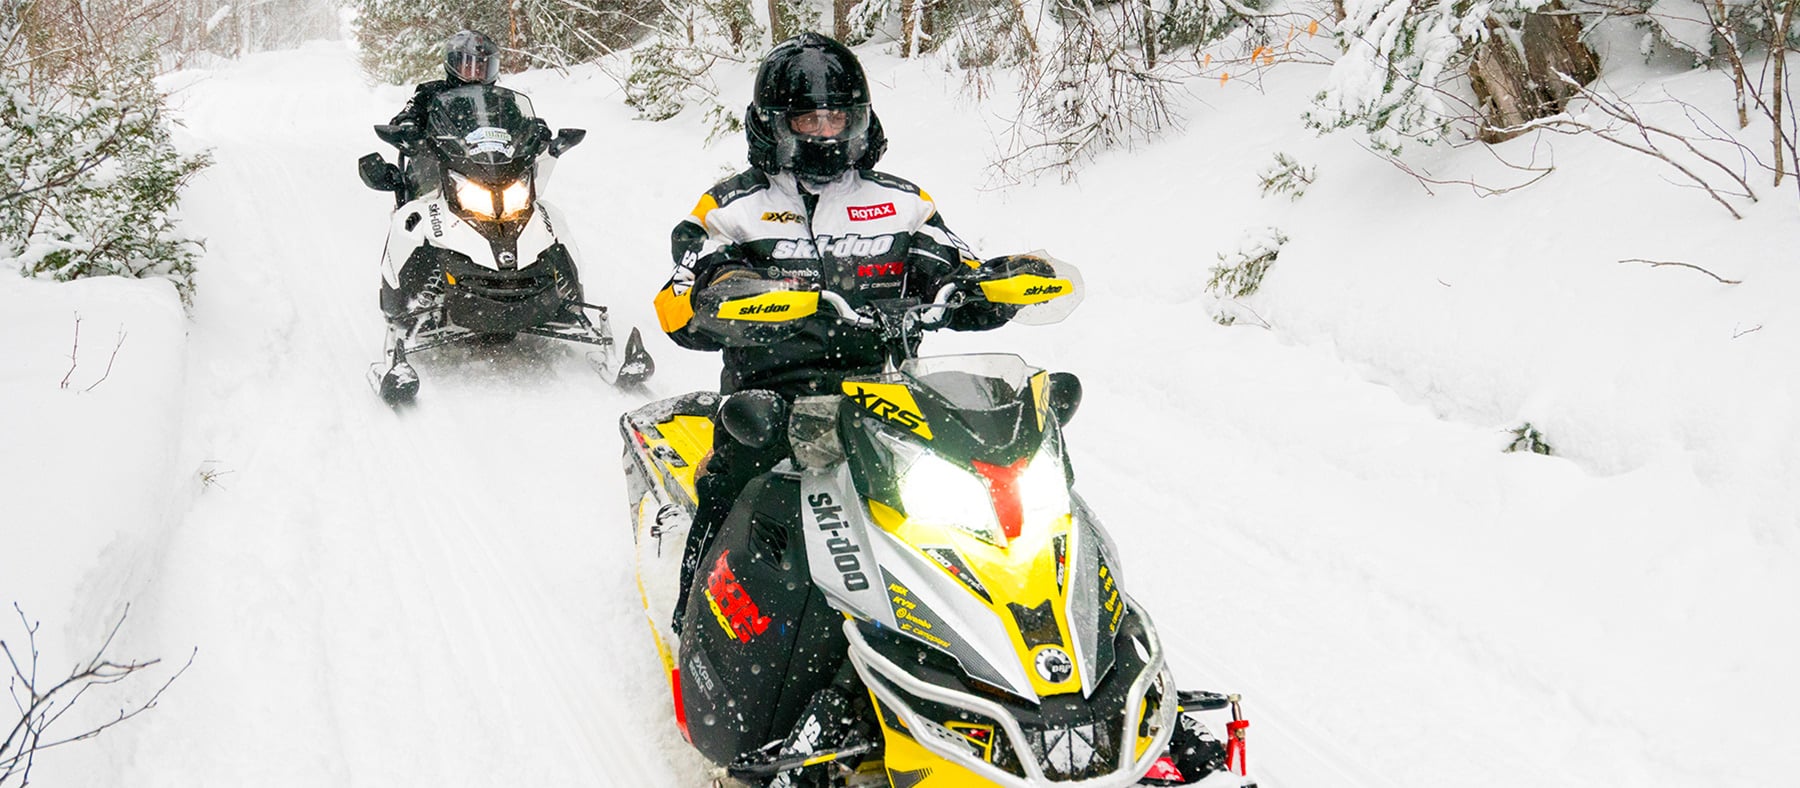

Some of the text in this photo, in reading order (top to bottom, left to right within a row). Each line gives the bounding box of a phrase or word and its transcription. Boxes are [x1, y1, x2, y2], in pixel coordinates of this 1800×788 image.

[429, 203, 443, 238] ski-doo
[851, 204, 894, 219] ROTAX
[772, 234, 895, 259] ski-doo
[781, 267, 819, 277] brembo
[1024, 285, 1063, 296] ski-doo
[738, 303, 791, 315] ski-doo
[854, 386, 926, 429] XRS
[808, 492, 869, 592] ski-doo
[905, 612, 932, 630] brembo
